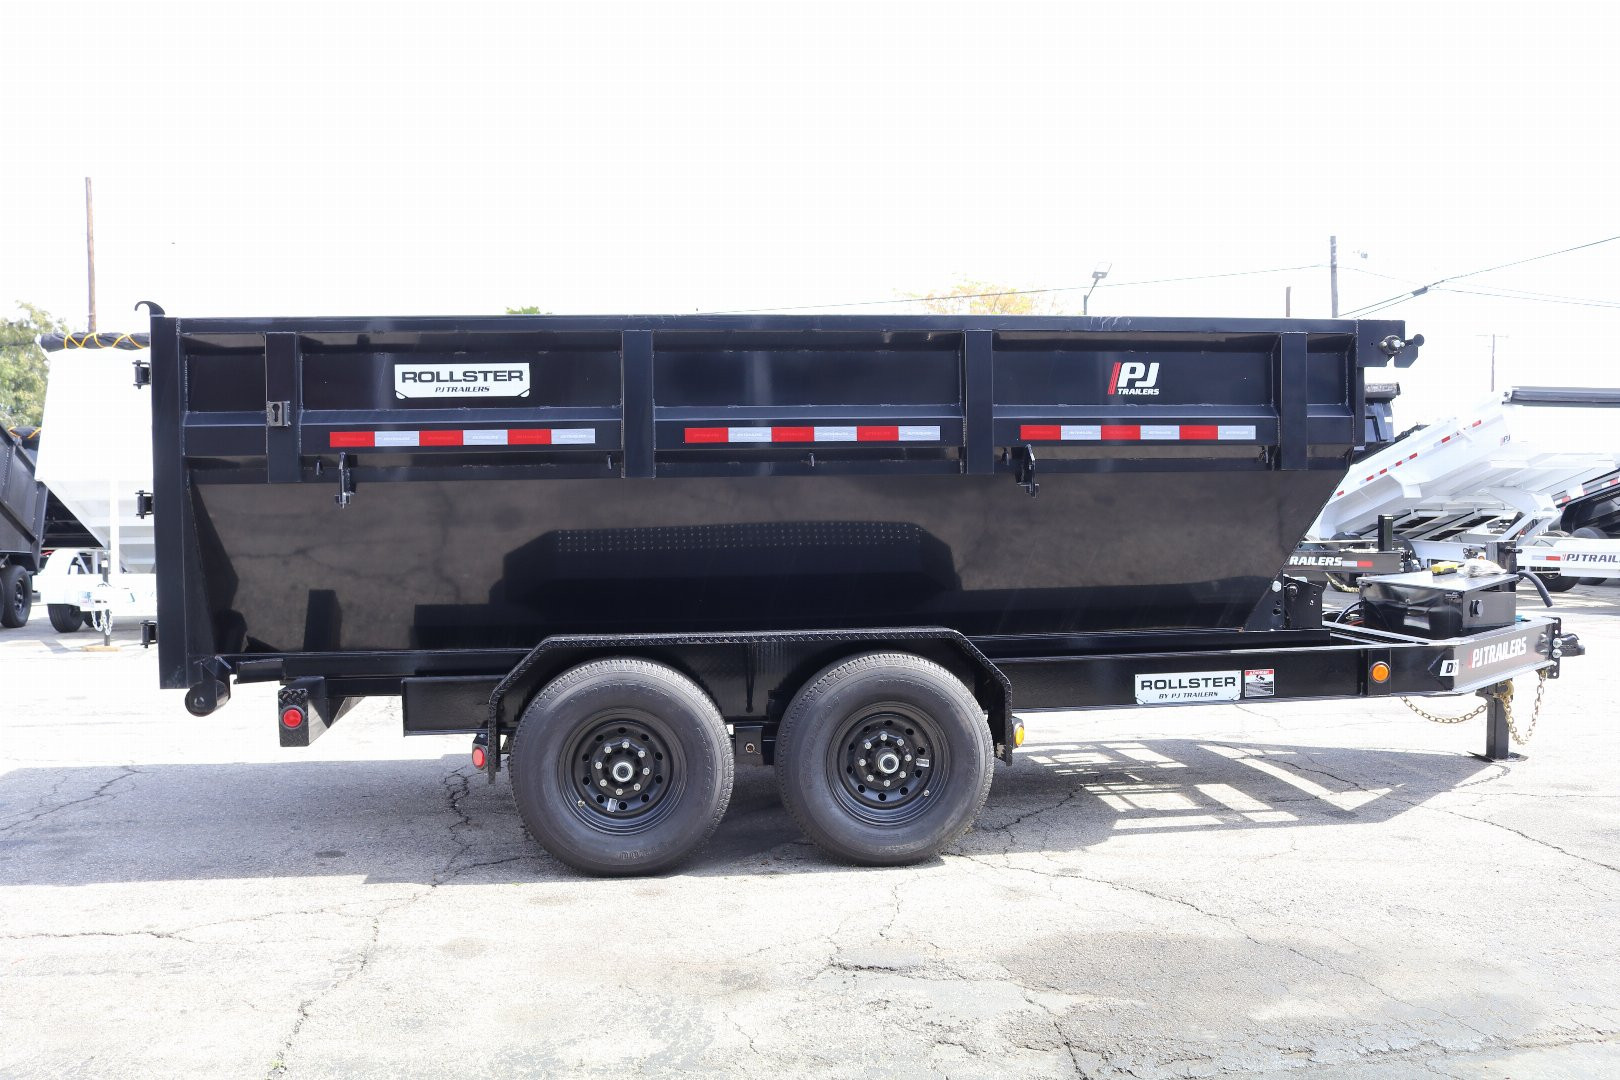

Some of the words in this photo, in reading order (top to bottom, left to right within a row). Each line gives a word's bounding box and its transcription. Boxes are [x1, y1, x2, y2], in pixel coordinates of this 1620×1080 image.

[402, 370, 523, 383] ROLLSTER
[1117, 362, 1160, 388] PJ
[1289, 555, 1343, 567] RAILERS
[1566, 553, 1580, 562] PJ
[1581, 554, 1620, 563] TRAIL
[1481, 636, 1527, 665] TRAILERS
[1140, 677, 1236, 690] ROLLSTER
[1183, 691, 1218, 699] TRAILERS
